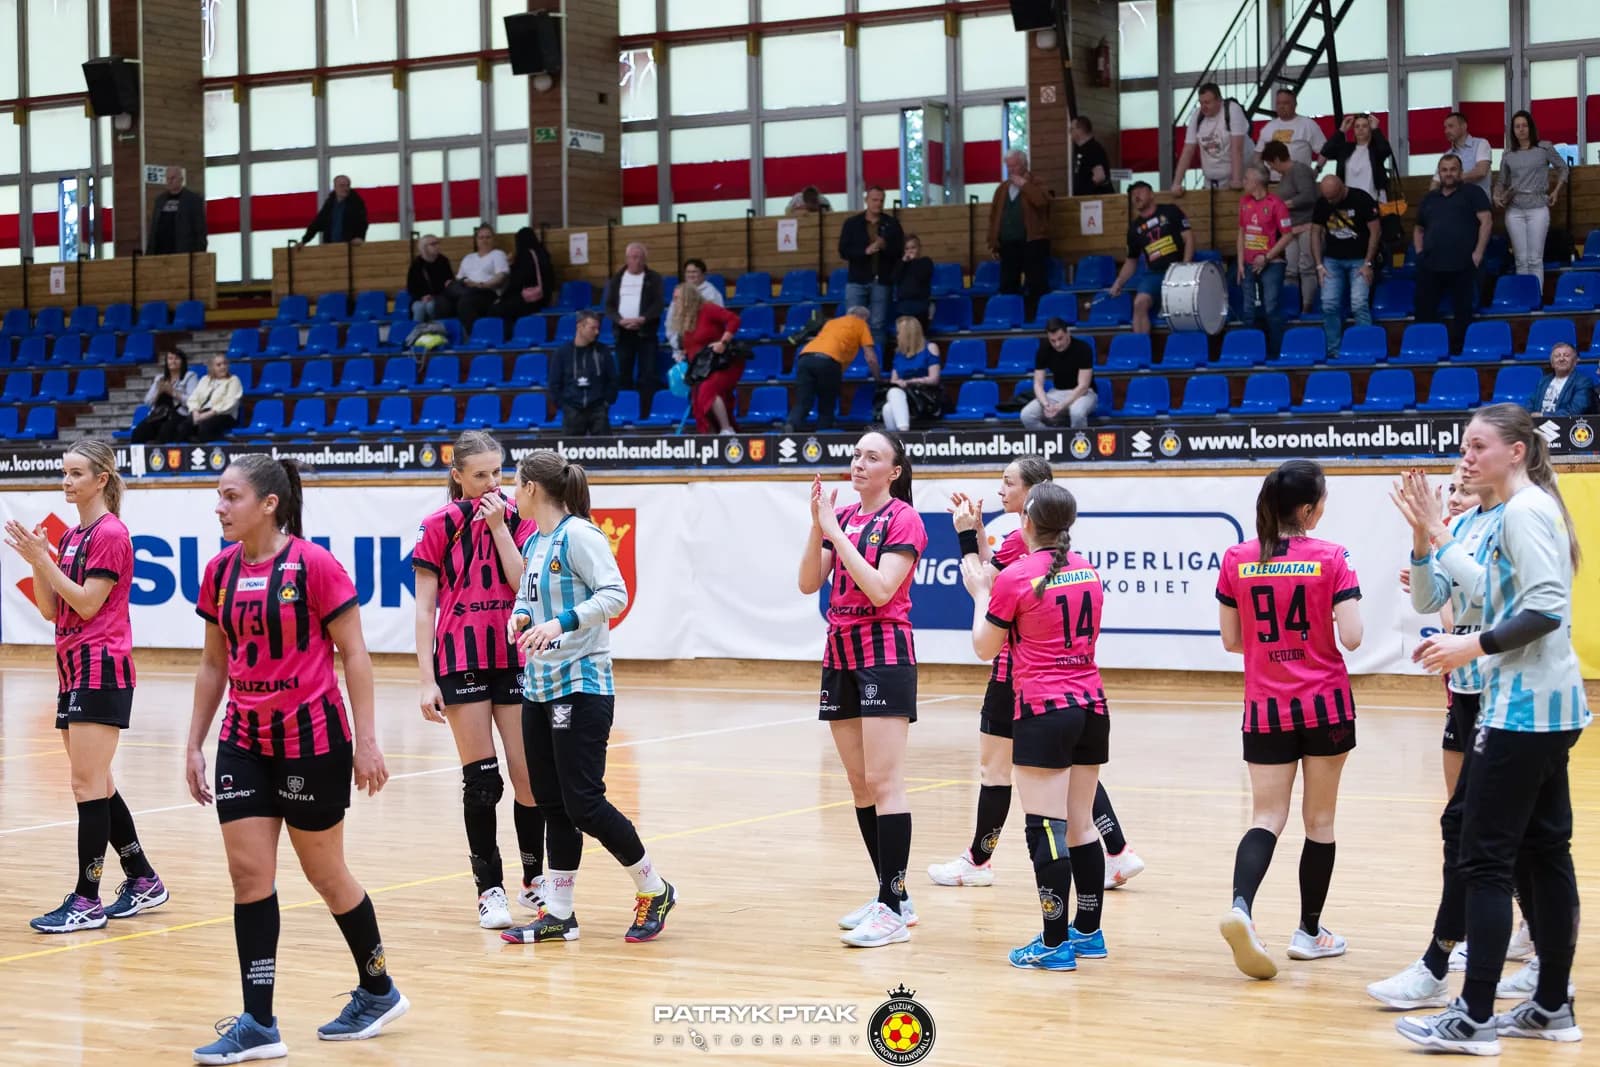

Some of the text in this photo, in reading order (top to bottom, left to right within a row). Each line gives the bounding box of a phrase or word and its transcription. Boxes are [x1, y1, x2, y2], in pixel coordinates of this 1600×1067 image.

[570, 137, 581, 147] A
[828, 433, 1064, 460] wwronahandball.pl
[1188, 423, 1460, 457] www.koronahandball.pl
[1074, 550, 1222, 571] UPERLIGA
[1241, 563, 1316, 576] LEWIATAN
[912, 557, 958, 586] NiG
[526, 573, 539, 602] 16
[1102, 580, 1190, 595] KOBIET
[469, 600, 514, 613] SUZUK
[1251, 584, 1311, 643] 94
[235, 600, 265, 637] 73
[1056, 590, 1095, 650] 14
[236, 676, 300, 693] SUZUKI
[216, 789, 250, 801] arabela
[278, 790, 315, 802] PROFIKA
